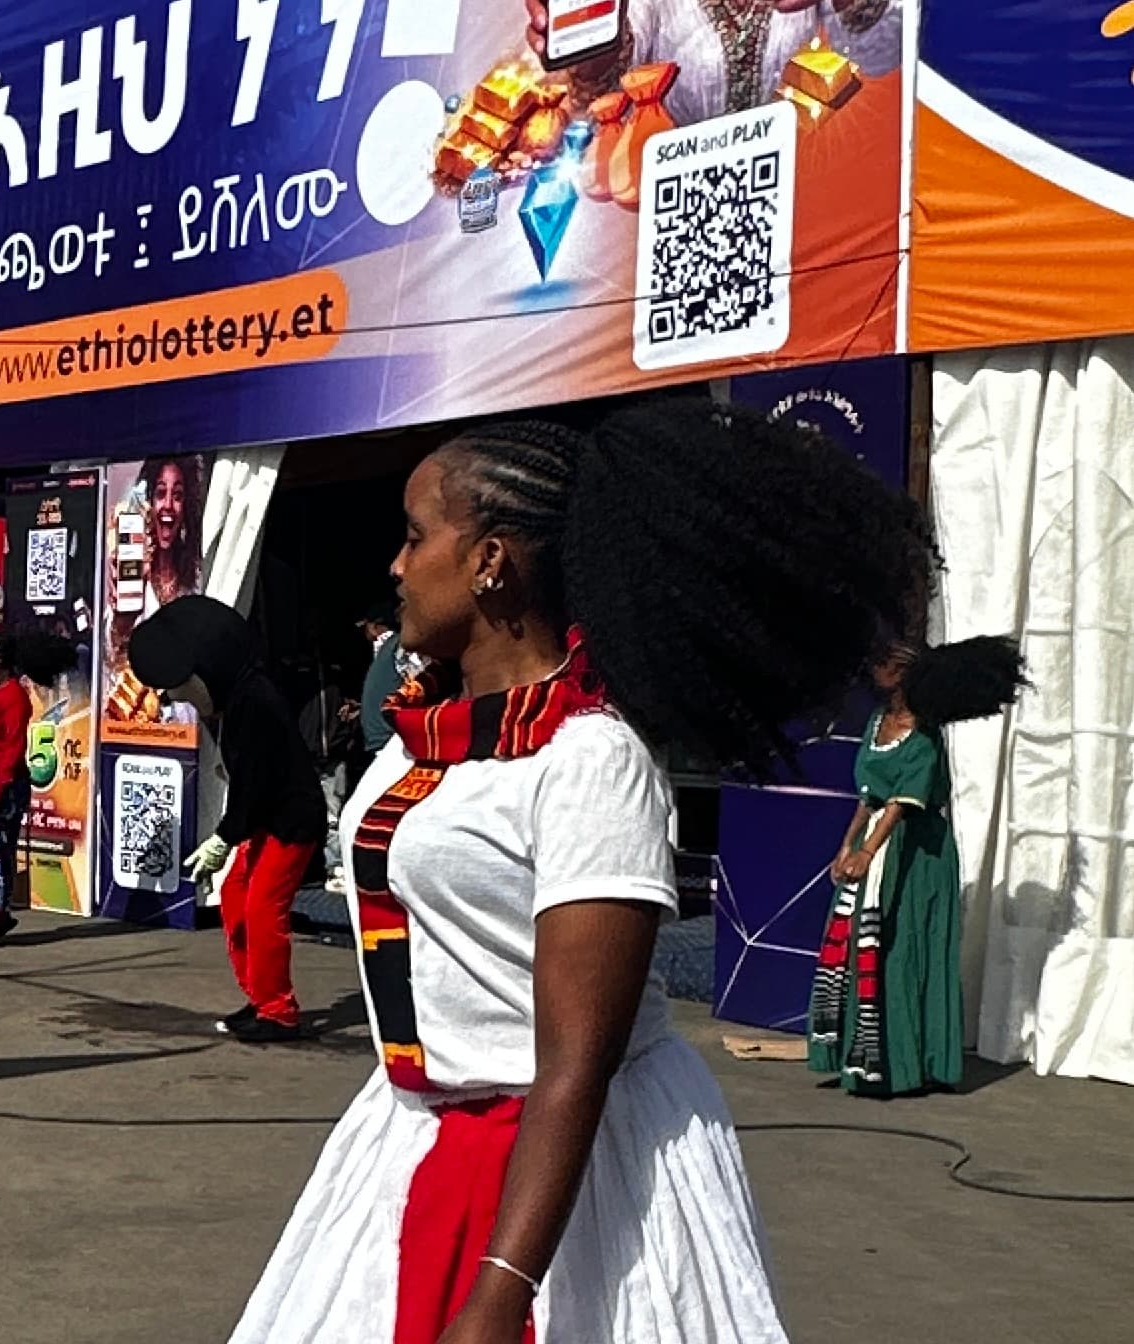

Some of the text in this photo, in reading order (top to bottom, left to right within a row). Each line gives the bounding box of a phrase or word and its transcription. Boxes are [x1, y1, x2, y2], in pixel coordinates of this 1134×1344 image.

[656, 116, 775, 165] SCAN and PLAY
[27, 720, 58, 787] 5
